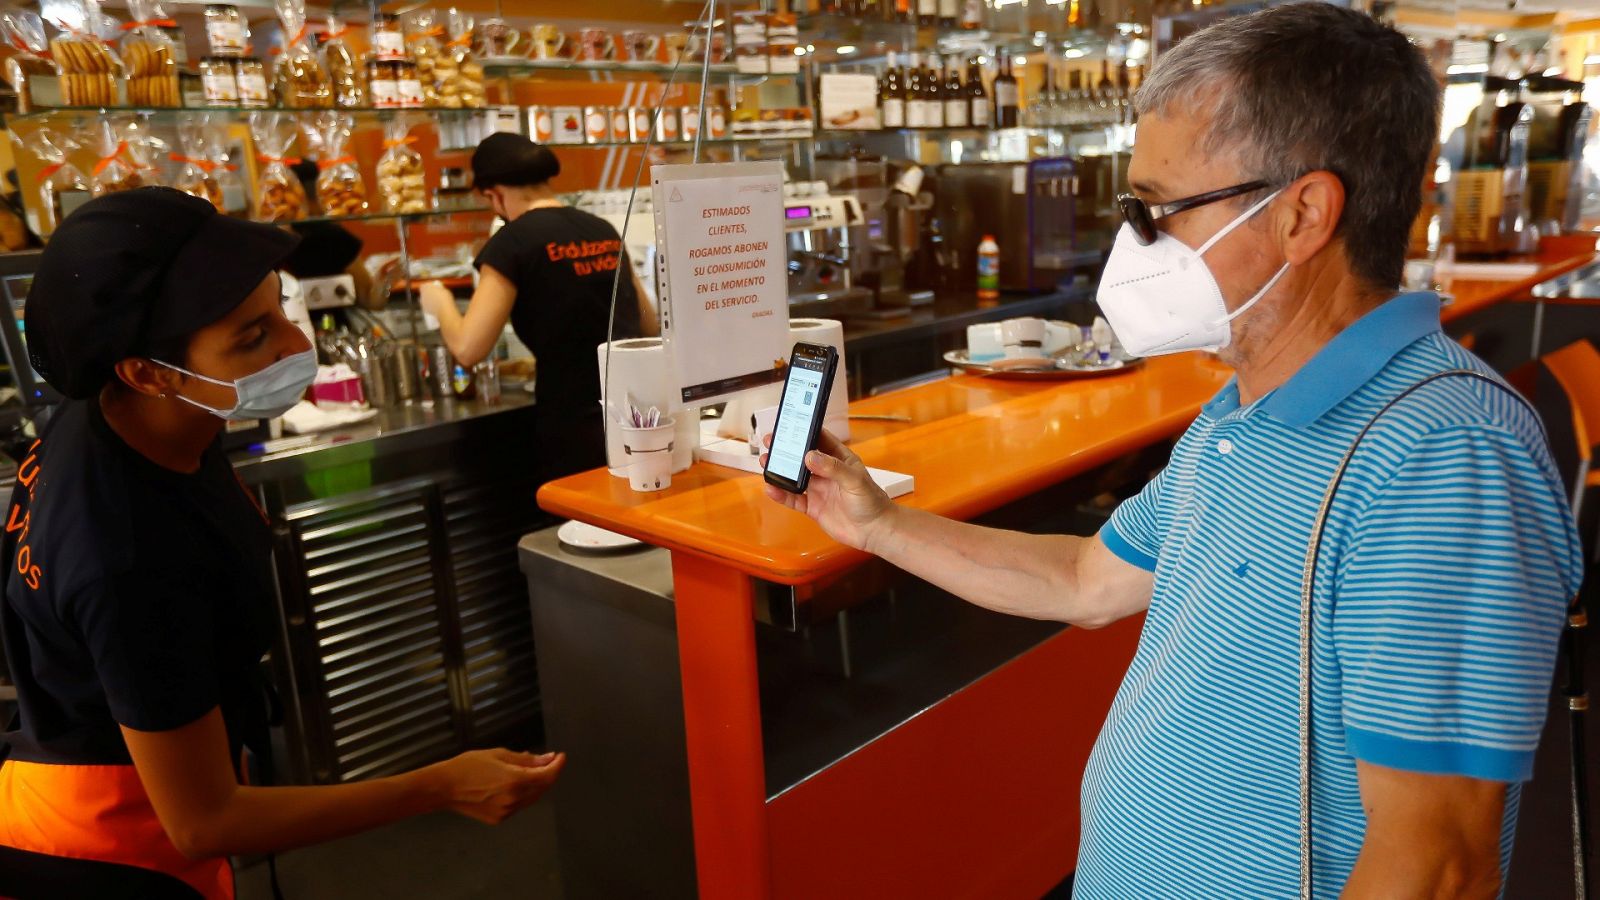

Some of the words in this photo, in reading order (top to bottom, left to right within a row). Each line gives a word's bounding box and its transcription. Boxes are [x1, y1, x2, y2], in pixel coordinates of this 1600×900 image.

[702, 206, 751, 219] ESTIMADOS
[708, 224, 747, 236] CLIENTES,
[689, 245, 732, 259] ROGAMOS
[734, 241, 768, 254] ABONEN
[694, 266, 705, 277] SU
[707, 258, 766, 275] CONSUMICIÓN
[697, 284, 708, 294] EN
[710, 283, 719, 292] EL
[721, 276, 765, 290] MOMENTO
[705, 301, 720, 311] DEL
[721, 294, 759, 308] SERVICIO.
